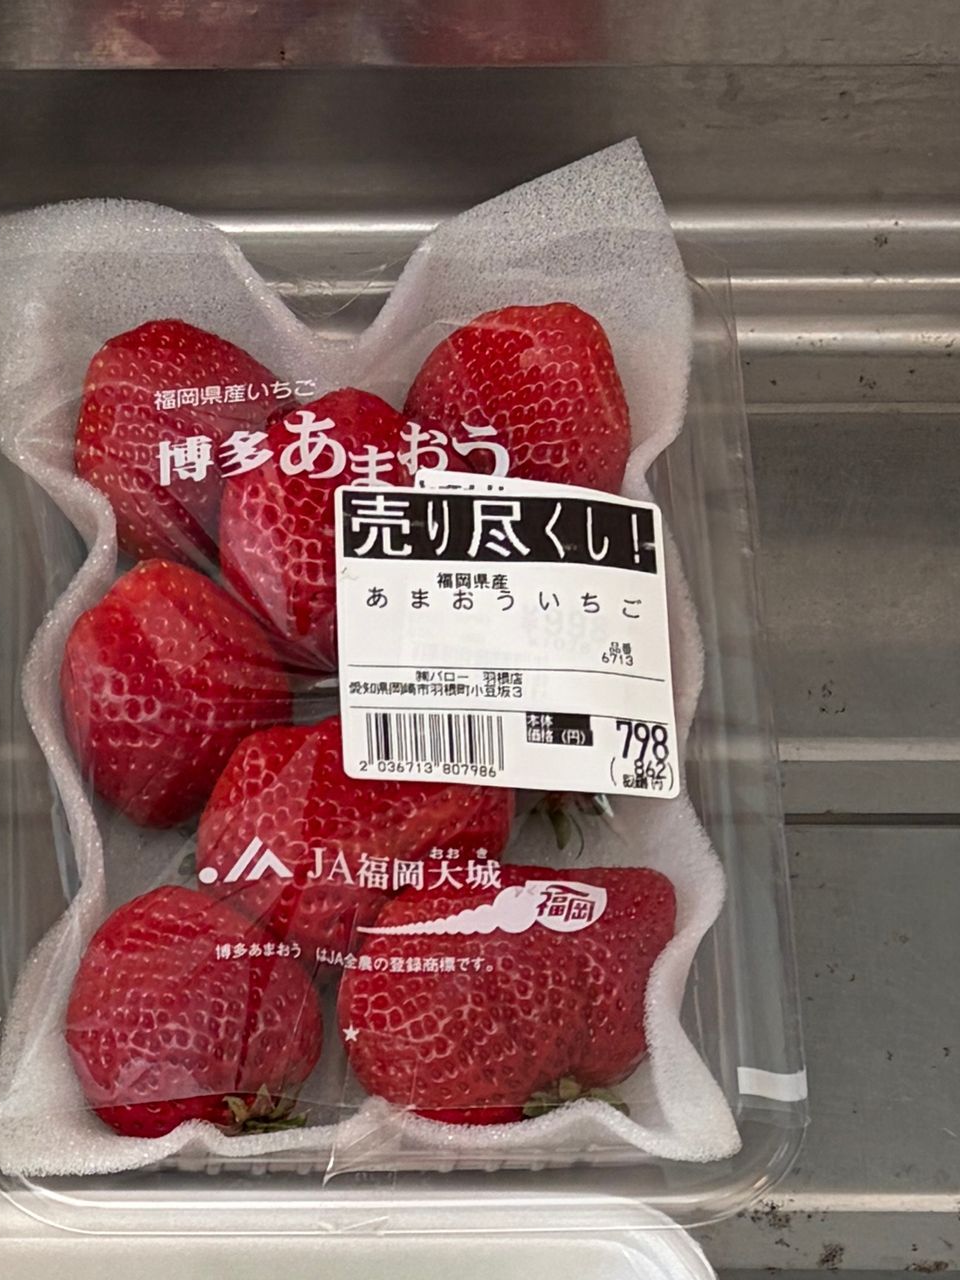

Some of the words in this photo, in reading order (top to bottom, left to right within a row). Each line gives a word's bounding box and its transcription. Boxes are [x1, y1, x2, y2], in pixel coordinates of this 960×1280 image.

[153, 379, 316, 411] 福岡県産いちご
[155, 411, 511, 487] 博多あまおう
[436, 572, 509, 590] 福岡県産
[365, 586, 643, 619] あまおういちご
[608, 641, 632, 655] 品番
[601, 652, 634, 667] 6713
[483, 671, 523, 686] 羽根店
[526, 713, 554, 727] 本体
[615, 720, 670, 762] 798
[359, 760, 369, 772] 2
[377, 761, 433, 774] 036713
[442, 763, 497, 778] 807986
[475, 846, 490, 860] き
[306, 847, 502, 891] JA福岡大城
[536, 885, 596, 924] 福岡
[215, 942, 302, 961] 博多あまおう
